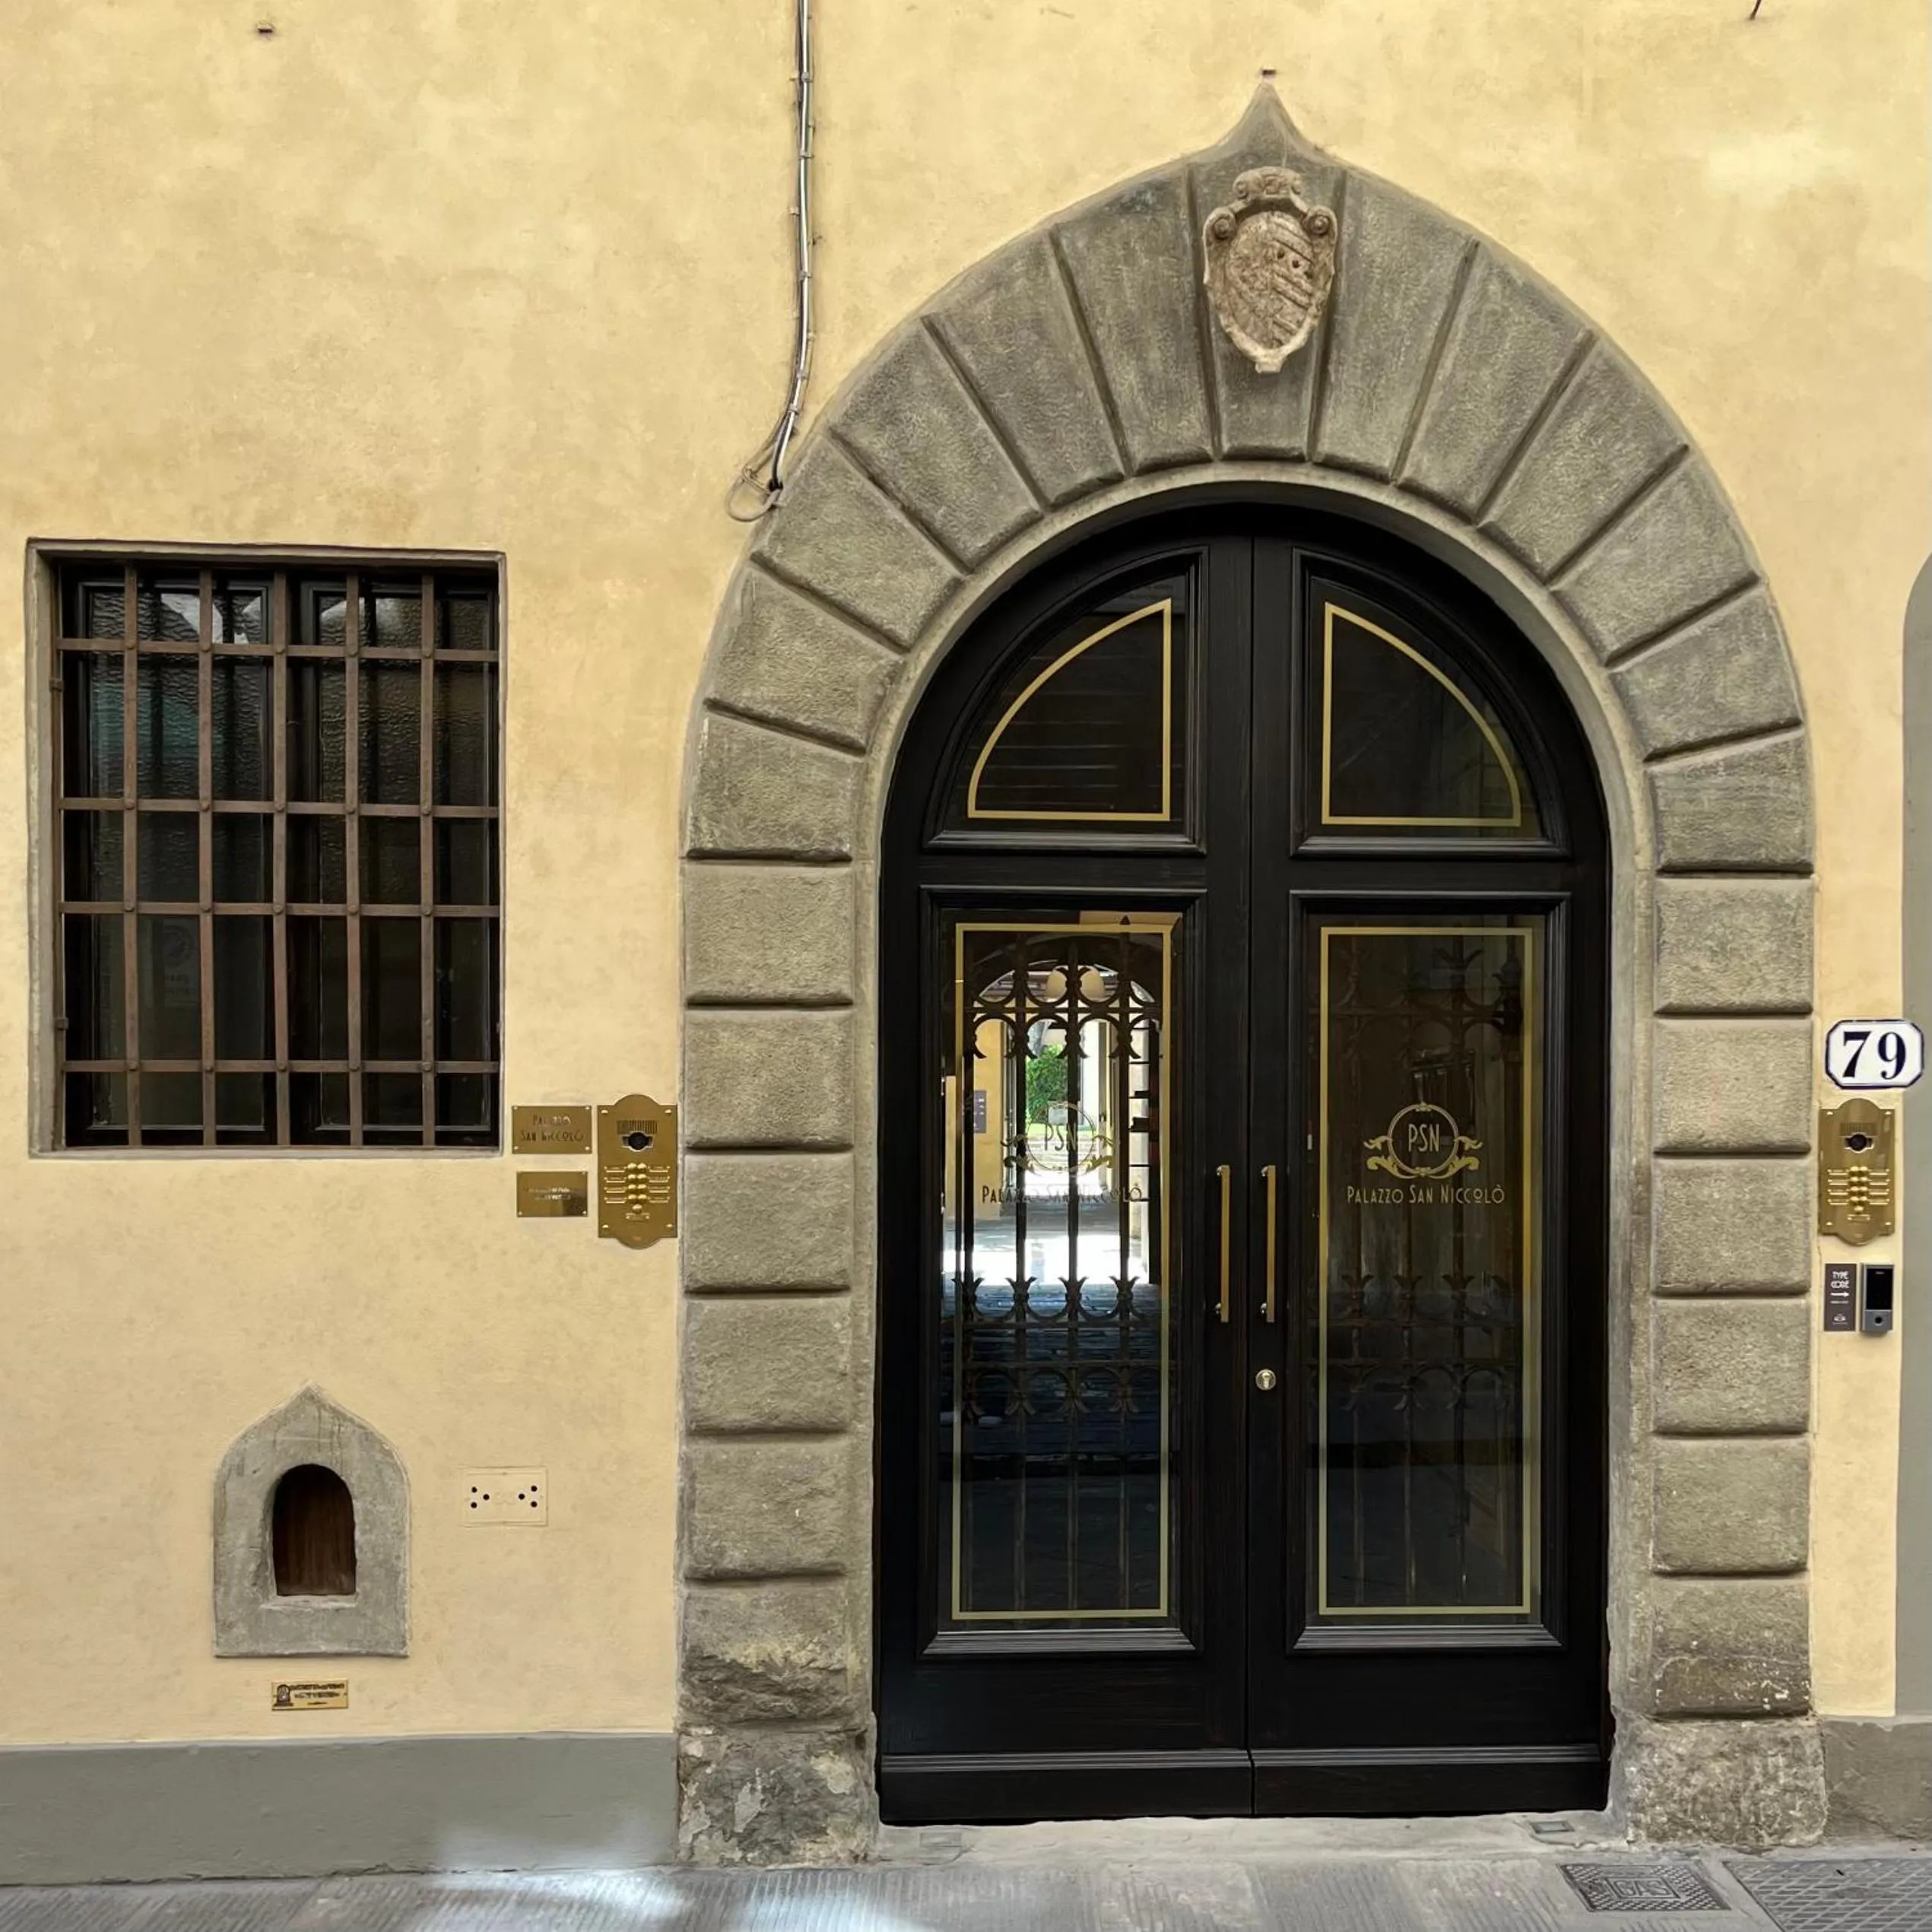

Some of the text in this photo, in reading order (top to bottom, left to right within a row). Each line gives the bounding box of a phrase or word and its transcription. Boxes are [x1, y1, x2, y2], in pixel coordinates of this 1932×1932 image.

[1842, 1031, 1906, 1080] 79
[1408, 1124, 1440, 1152] PSN
[1347, 1185, 1404, 1204] PALAZZO
[1409, 1185, 1433, 1204] SAN
[1612, 1880, 1672, 1896] GAS
